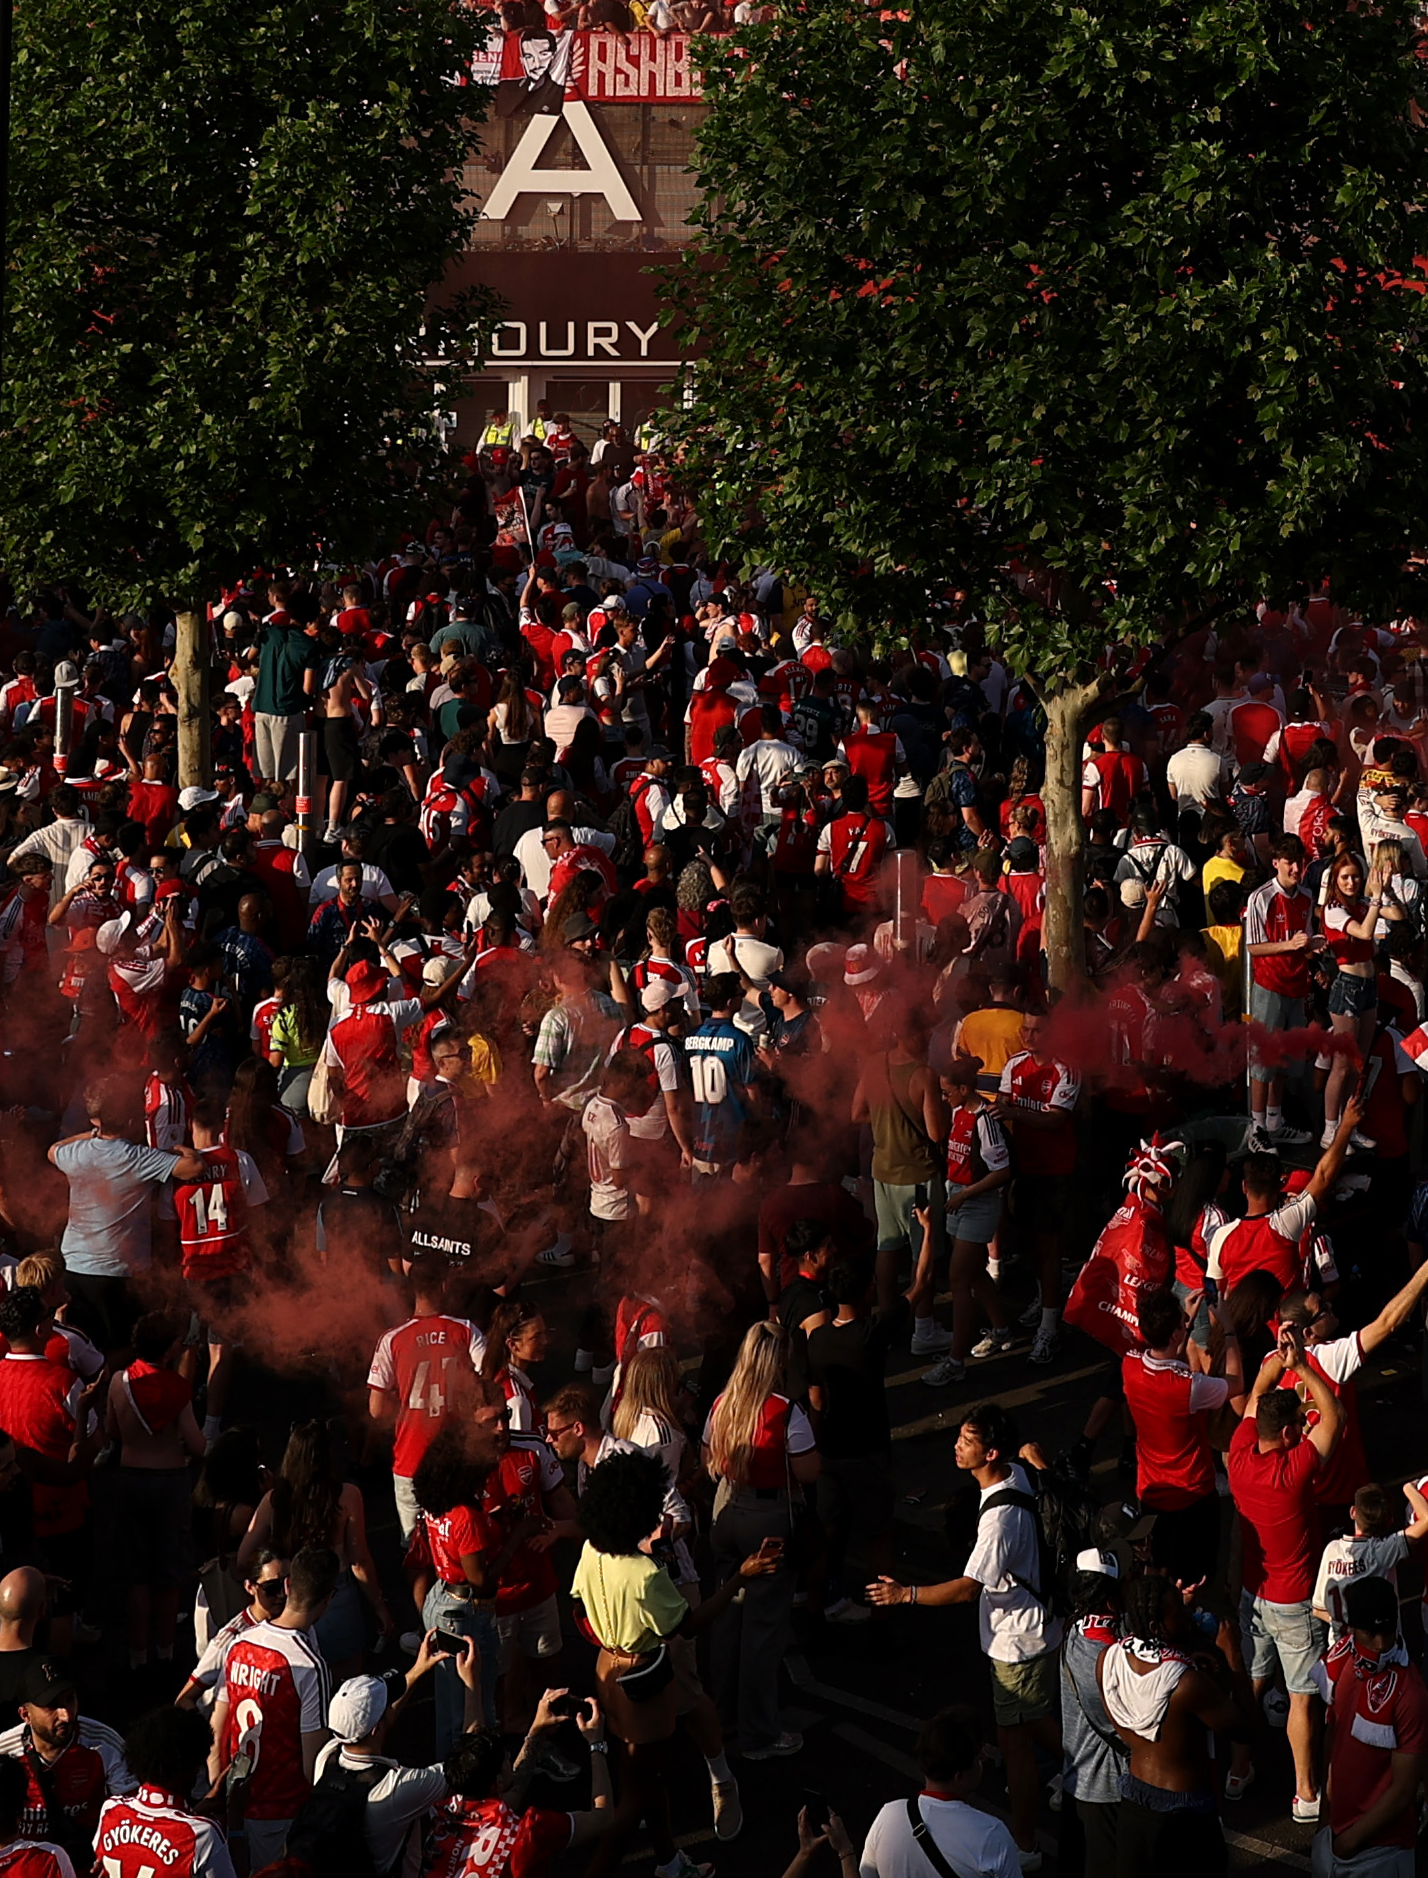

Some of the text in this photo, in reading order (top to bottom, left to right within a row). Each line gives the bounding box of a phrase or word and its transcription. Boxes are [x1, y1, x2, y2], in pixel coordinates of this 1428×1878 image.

[789, 676, 808, 703] 17
[684, 1035, 734, 1052] BERGKAMP
[690, 1054, 727, 1104] 10
[189, 1183, 227, 1234] 14
[411, 1229, 471, 1256] ALLSANTS
[415, 1330, 447, 1347] RICE
[230, 1662, 280, 1697] WRIGHT
[236, 1698, 263, 1772] 8
[103, 1818, 174, 1866] GYÖKERES
